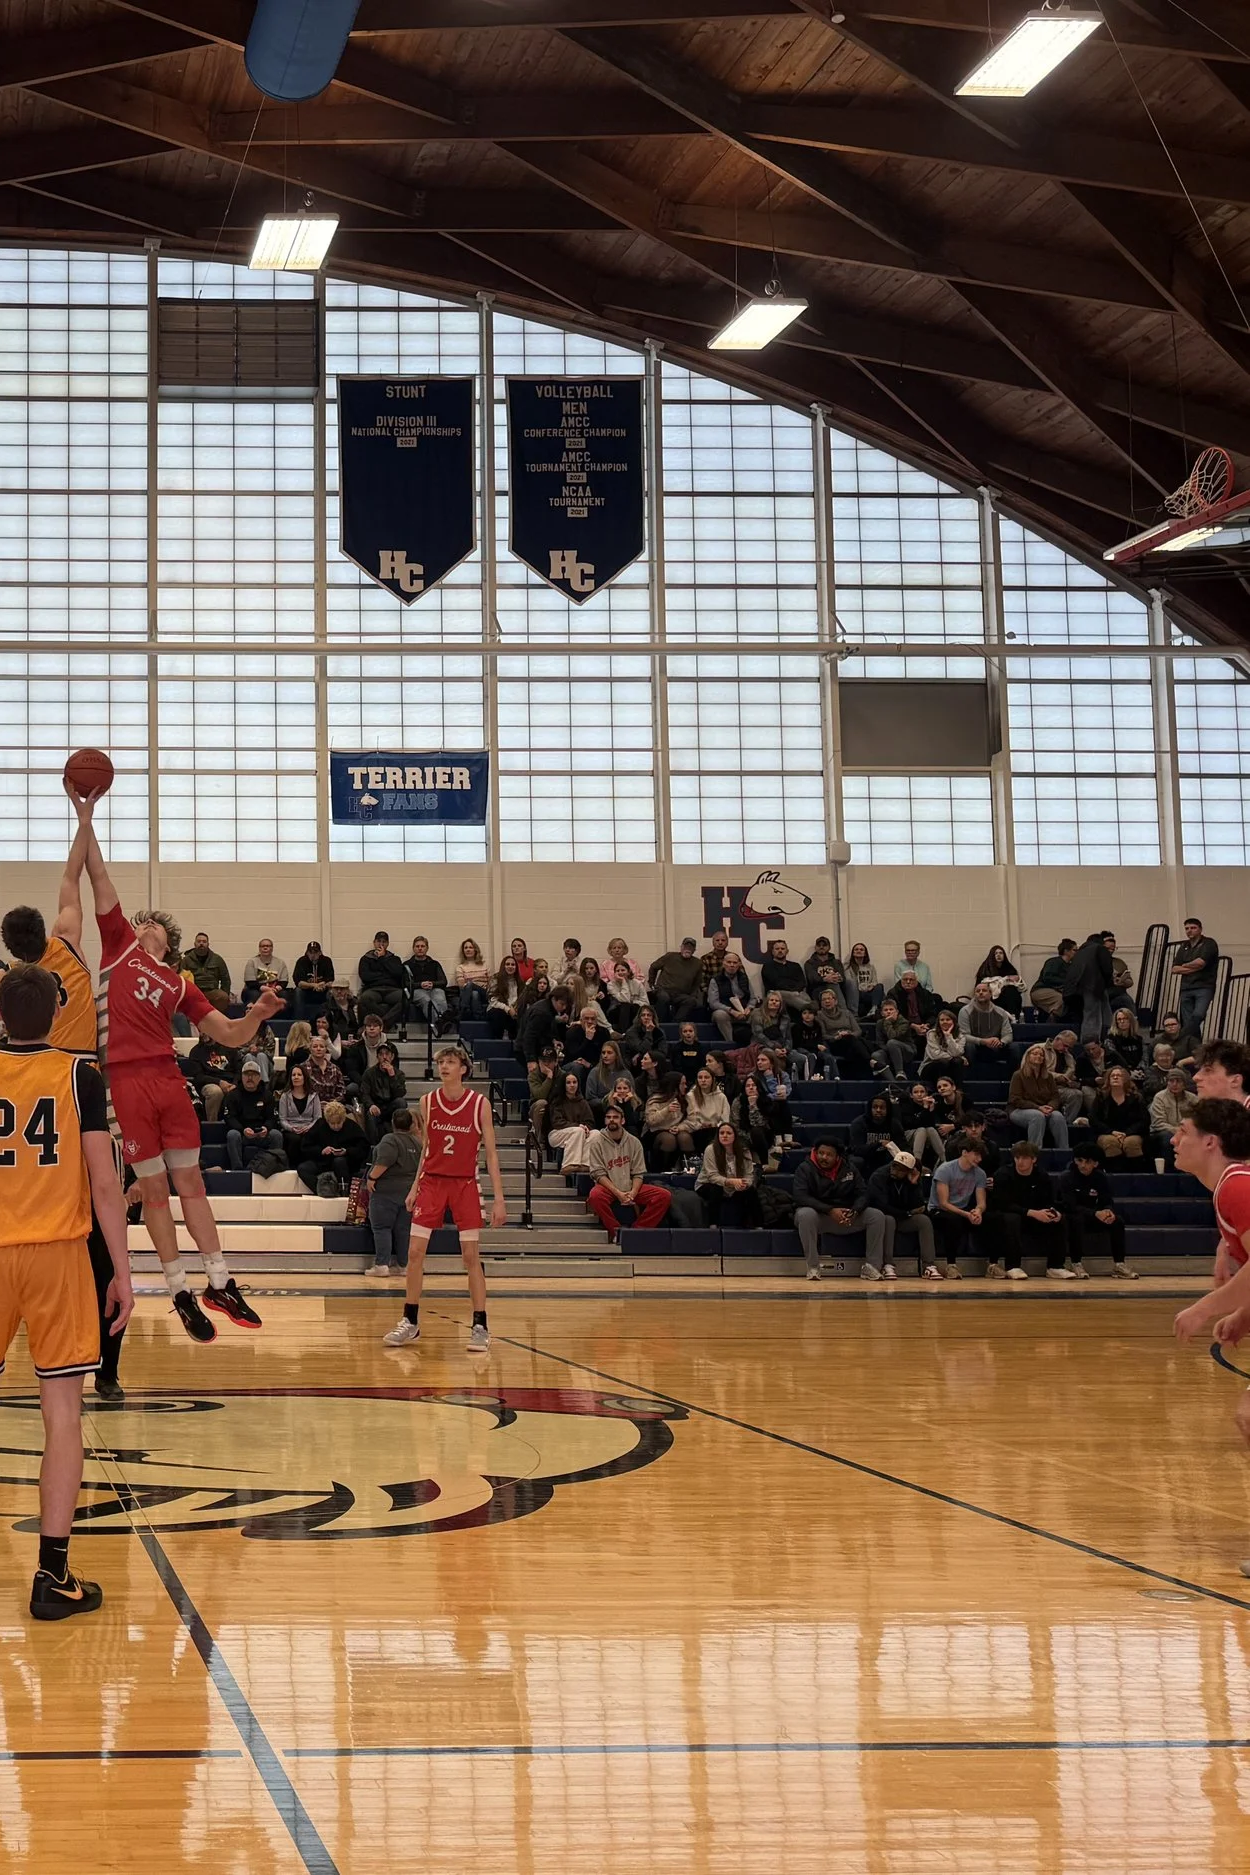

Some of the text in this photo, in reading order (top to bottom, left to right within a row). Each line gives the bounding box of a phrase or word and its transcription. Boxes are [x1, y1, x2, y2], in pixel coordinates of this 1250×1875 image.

[385, 385, 427, 398] STUNT
[535, 385, 614, 398] VOLLEYBALL
[562, 401, 588, 414] MEN
[376, 415, 437, 427] DIVISION III
[560, 416, 590, 428] AMCC
[351, 427, 462, 437] NATIONAL CHAMPIONSHIPS
[523, 428, 626, 438] CONFERENCE CHAMPION
[561, 451, 591, 463] AMCC
[525, 463, 628, 472] TOURNAMENT CHAMPION
[562, 485, 592, 497] NCAA
[548, 497, 606, 507] TOURNAMENT
[378, 550, 425, 593] HC
[549, 550, 595, 593] HC
[347, 766, 471, 790] TERRIER
[382, 793, 438, 810] FANS
[701, 886, 785, 965] HC
[128, 958, 179, 994] Crestwood
[133, 976, 164, 1009] 34
[431, 1119, 473, 1133] Crestwood
[443, 1134, 455, 1155] 2
